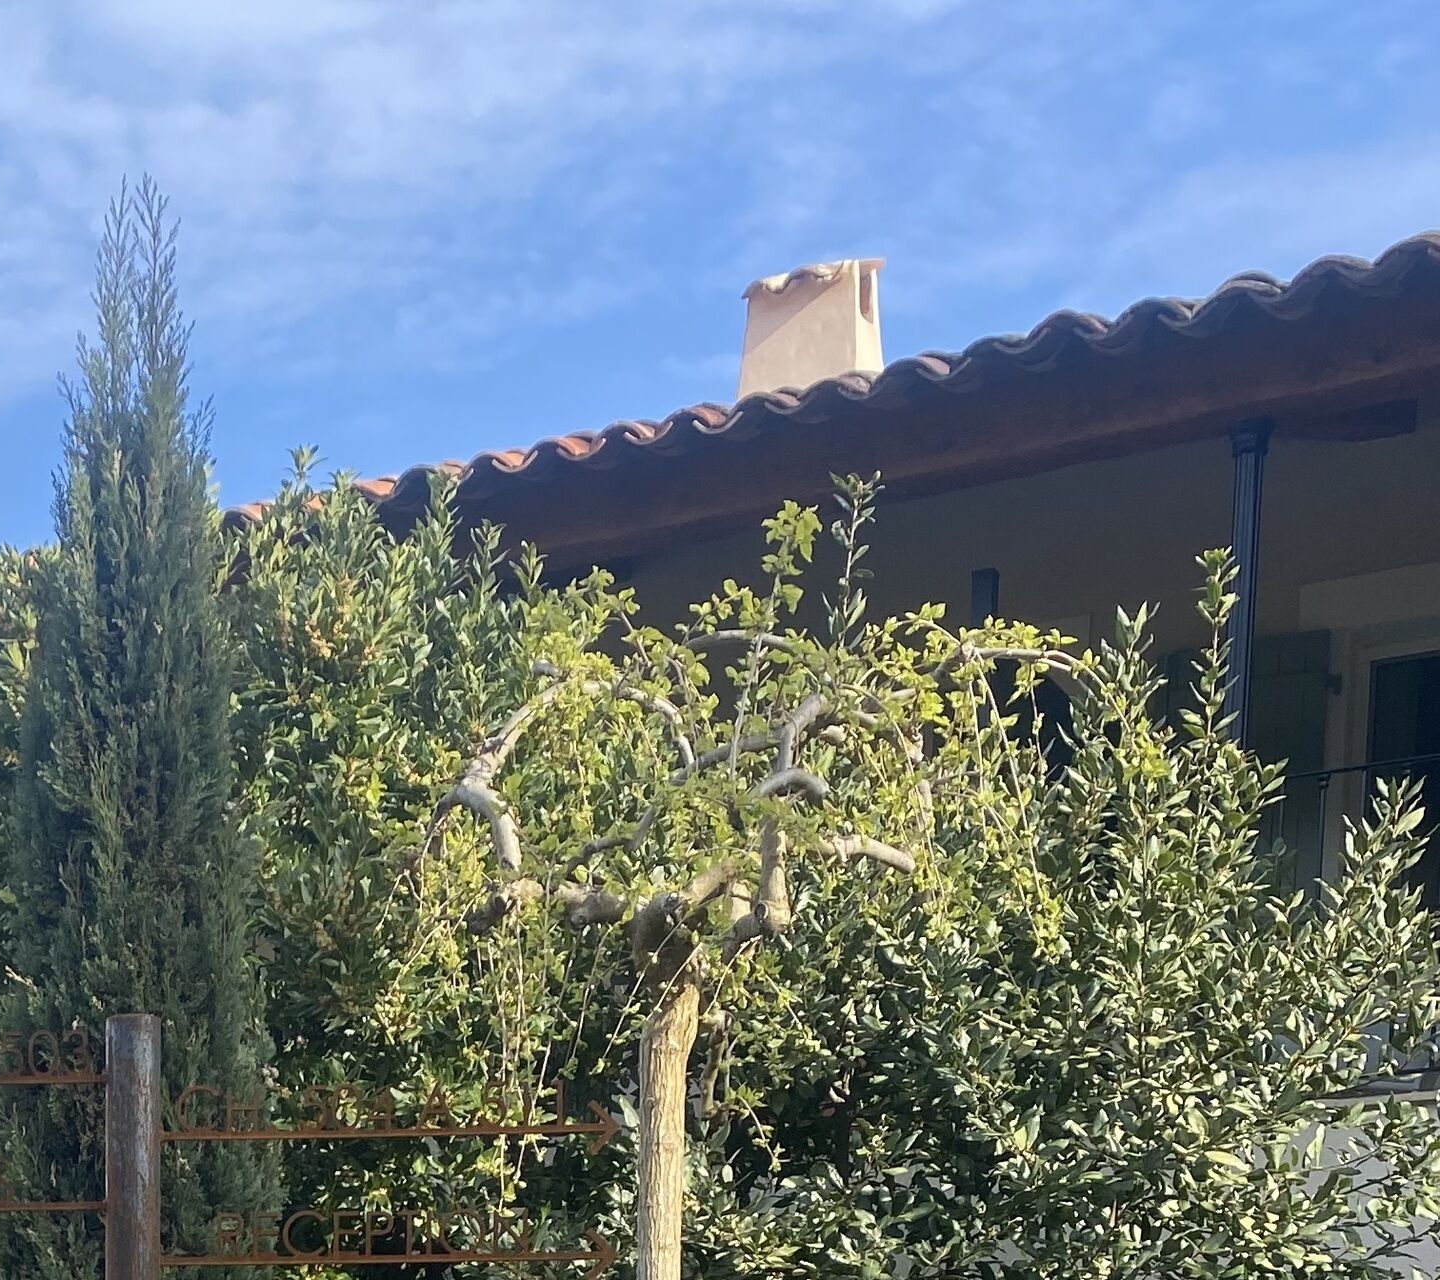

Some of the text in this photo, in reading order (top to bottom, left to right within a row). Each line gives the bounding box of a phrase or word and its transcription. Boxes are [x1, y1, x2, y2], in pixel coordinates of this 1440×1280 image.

[0, 1029, 94, 1077] 503
[175, 1083, 260, 1132] CH
[216, 1207, 531, 1256] RECEPTION
